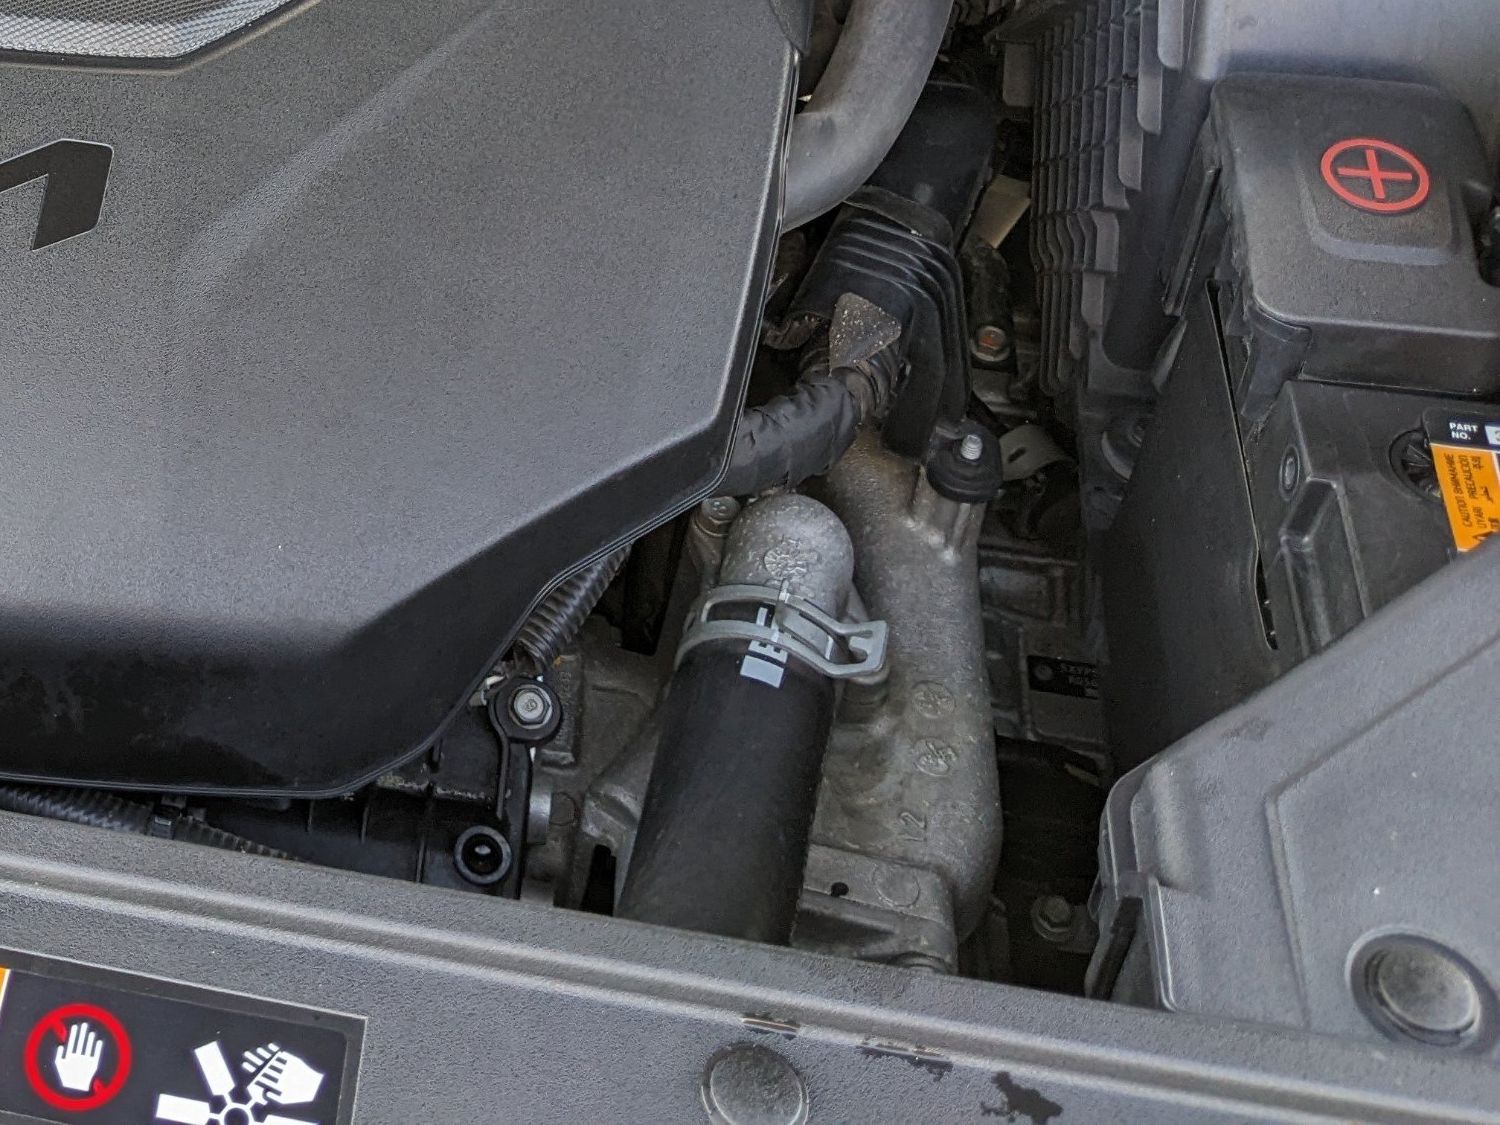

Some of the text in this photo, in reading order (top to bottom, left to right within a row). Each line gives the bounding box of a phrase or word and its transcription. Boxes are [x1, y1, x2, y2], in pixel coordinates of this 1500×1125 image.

[1449, 422, 1479, 433] PART
[1451, 431, 1472, 441] NO.
[1455, 496, 1473, 528] CAUTION
